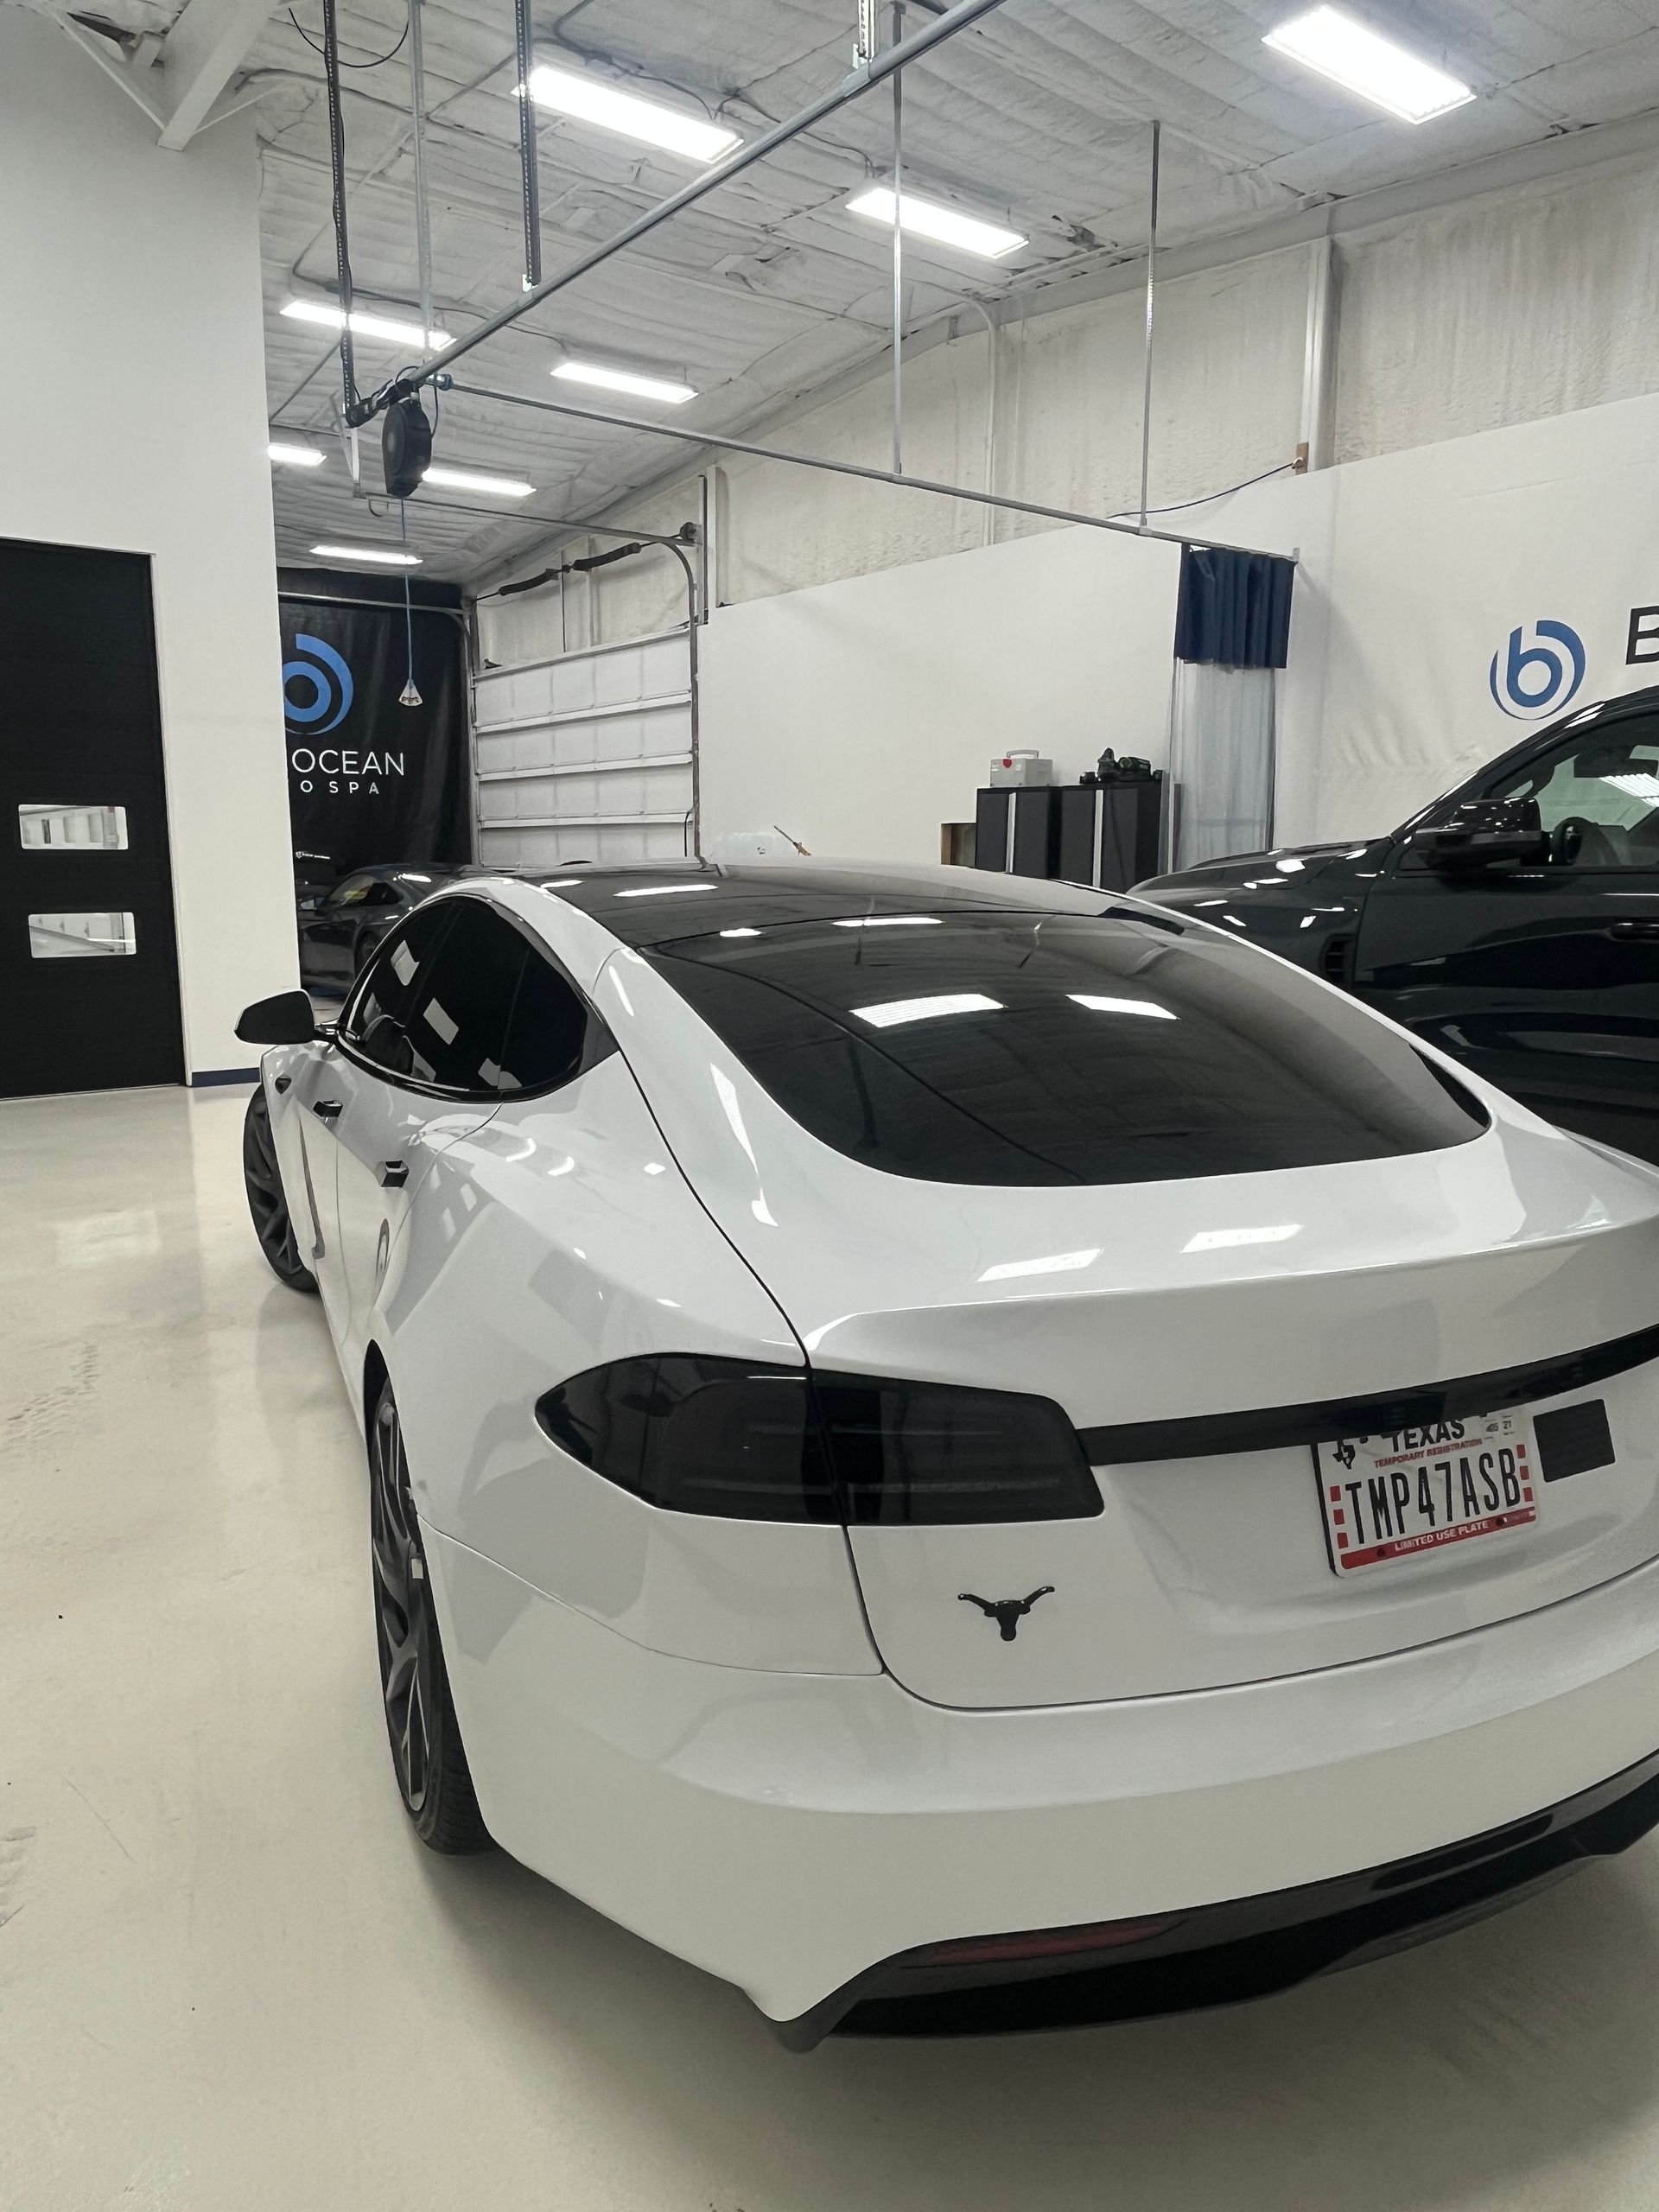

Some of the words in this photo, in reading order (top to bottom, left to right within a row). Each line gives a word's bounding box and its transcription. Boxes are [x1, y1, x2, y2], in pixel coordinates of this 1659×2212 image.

[291, 748, 404, 776] OCEAN
[328, 780, 379, 795] SPA
[1381, 1420, 1465, 1452] TEXAS
[1374, 1450, 1425, 1468] TEMPORARY
[1426, 1438, 1483, 1457] REGISTRATION
[1345, 1448, 1521, 1544] TMP47ASB
[1395, 1534, 1434, 1552] LIMITED
[1435, 1529, 1457, 1541] USE
[1458, 1520, 1490, 1536] PLATE
